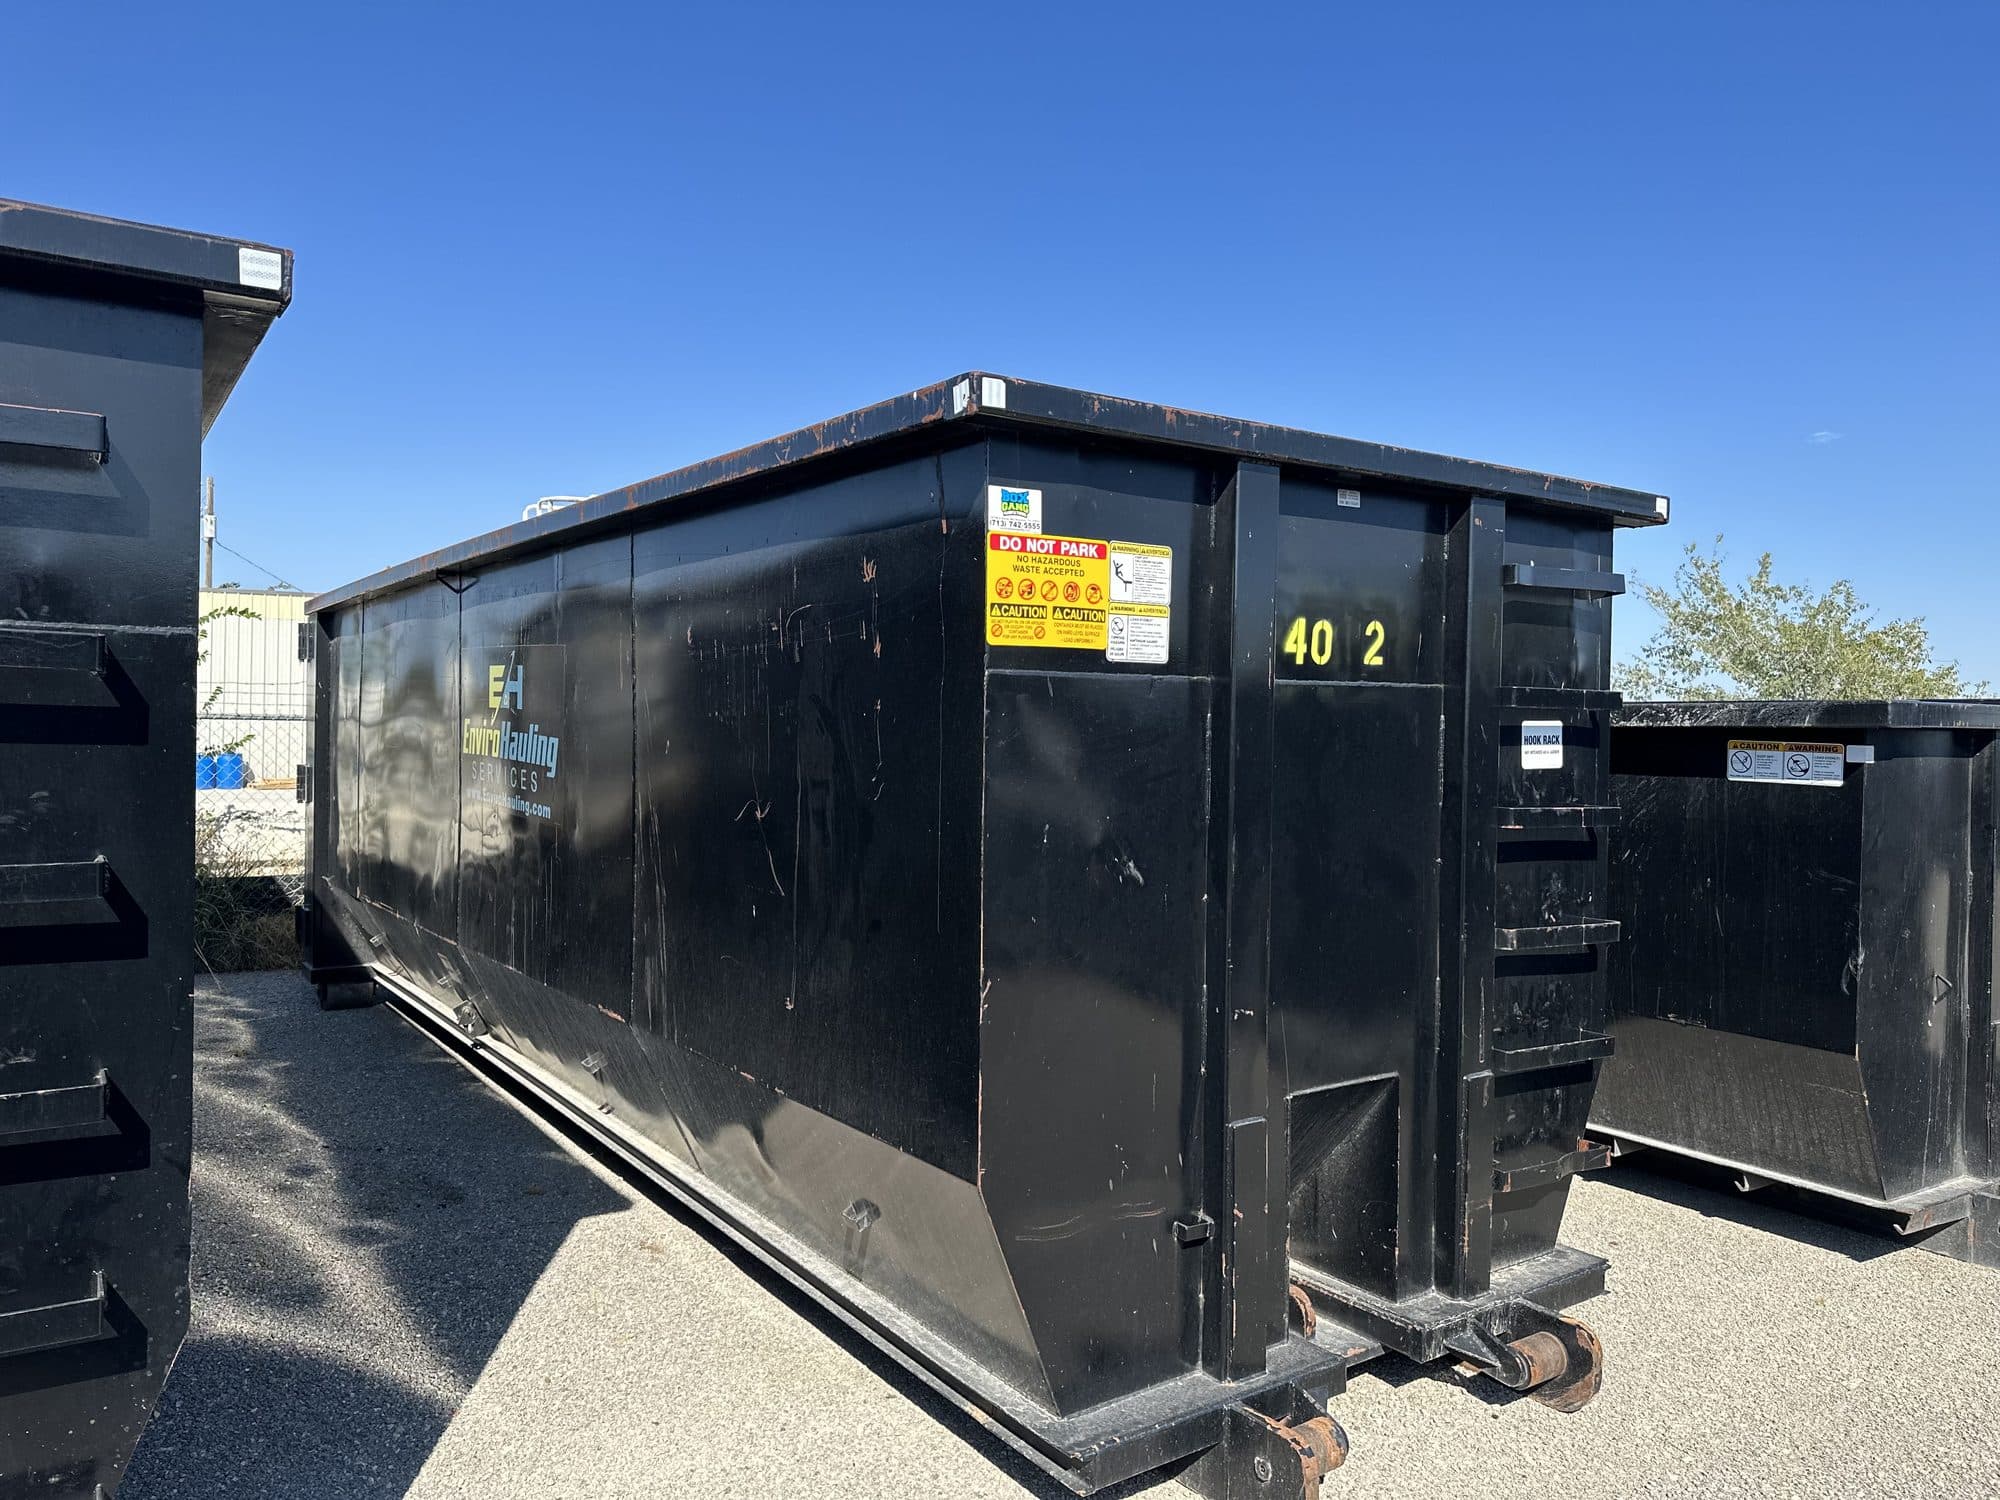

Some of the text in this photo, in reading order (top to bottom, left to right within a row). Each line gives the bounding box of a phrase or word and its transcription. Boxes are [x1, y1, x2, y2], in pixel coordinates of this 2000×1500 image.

[1001, 488, 1029, 503] BOX
[1001, 502, 1030, 514] GANG
[999, 536, 1099, 558] DO NOT PARK
[1016, 555, 1081, 567] NO HAZARDOUS
[1012, 565, 1085, 577] WASTE ACCEPTED
[1001, 604, 1105, 622] CAUTION CAUTION
[1284, 616, 1385, 666] 40 2
[1524, 734, 1560, 745] HOOK RACK
[462, 718, 560, 779] EnviroHauling
[1739, 742, 1839, 753] CAUTION WARNING
[471, 760, 539, 793] SERVICES
